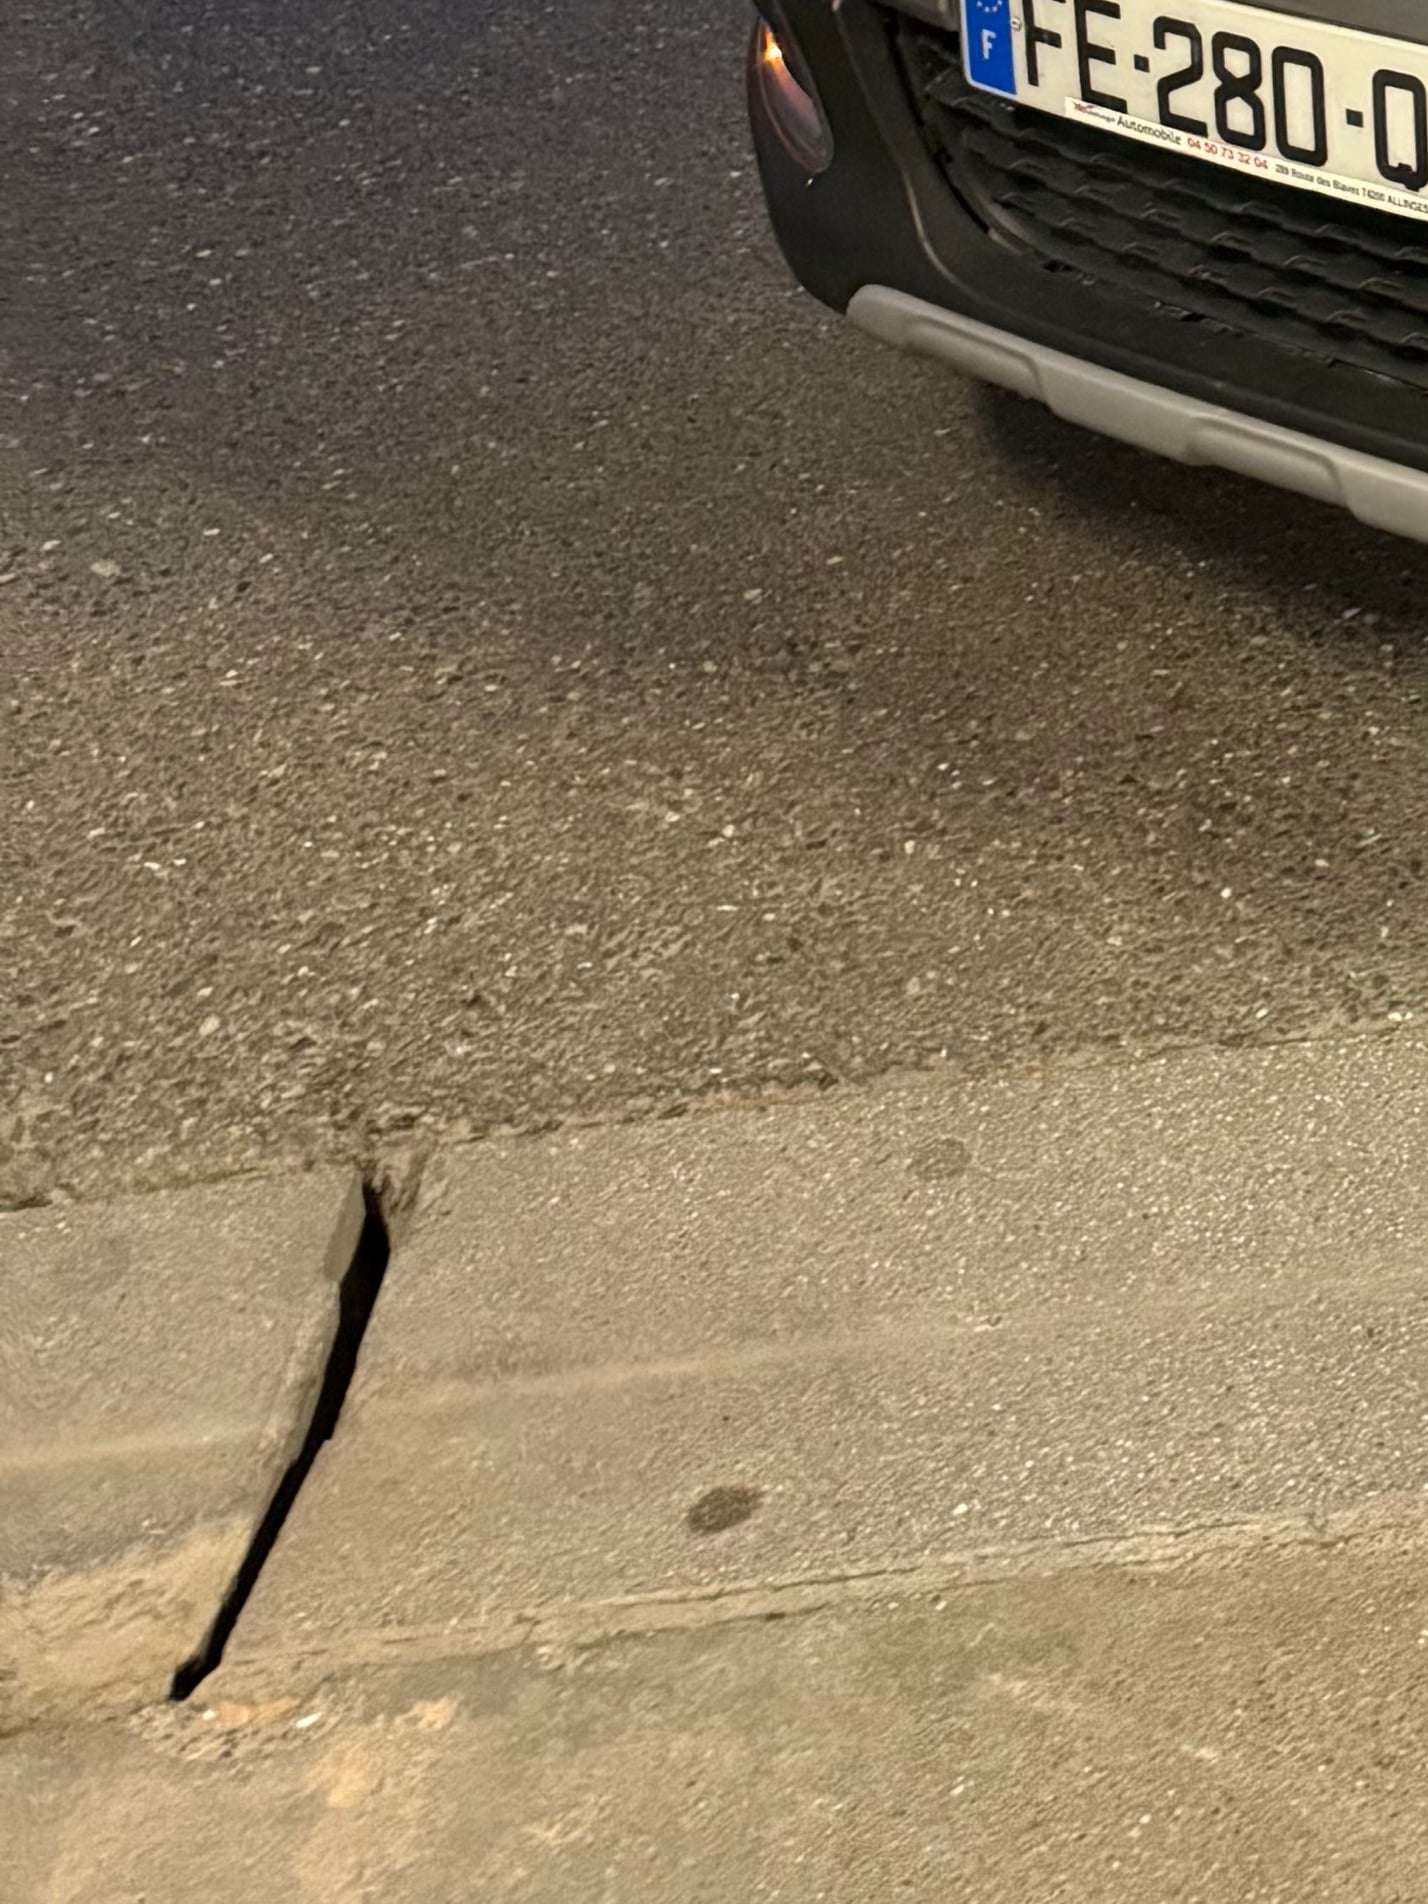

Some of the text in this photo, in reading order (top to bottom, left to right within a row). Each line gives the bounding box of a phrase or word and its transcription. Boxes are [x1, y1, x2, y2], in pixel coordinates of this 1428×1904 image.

[981, 28, 996, 61] F
[1116, 116, 1182, 145] Automobile
[1187, 137, 1201, 149] 04
[1204, 142, 1218, 155] 50
[1253, 156, 1268, 169] 04
[1291, 168, 1315, 183] Route
